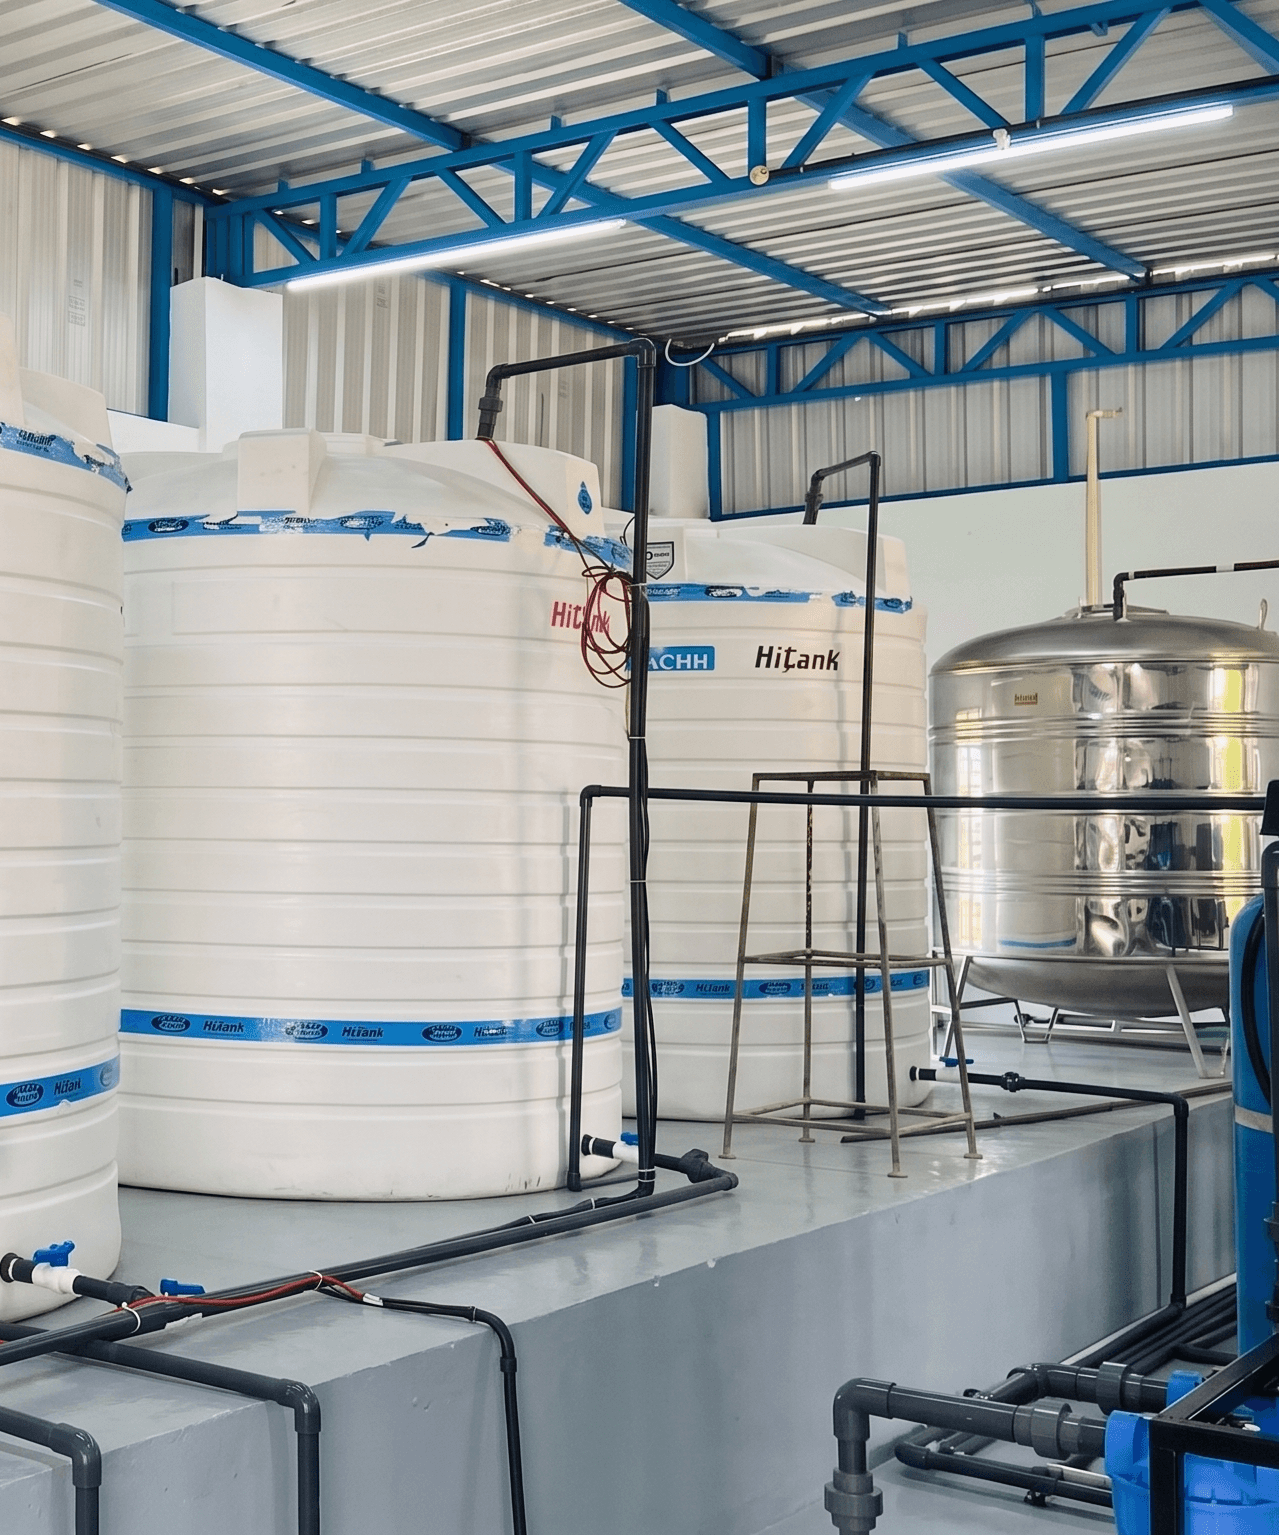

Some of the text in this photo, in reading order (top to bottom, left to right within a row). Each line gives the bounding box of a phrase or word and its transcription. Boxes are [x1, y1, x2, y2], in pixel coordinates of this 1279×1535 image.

[551, 601, 611, 634] Hitnk
[648, 653, 708, 670] ACHH
[755, 645, 841, 673] Hitank
